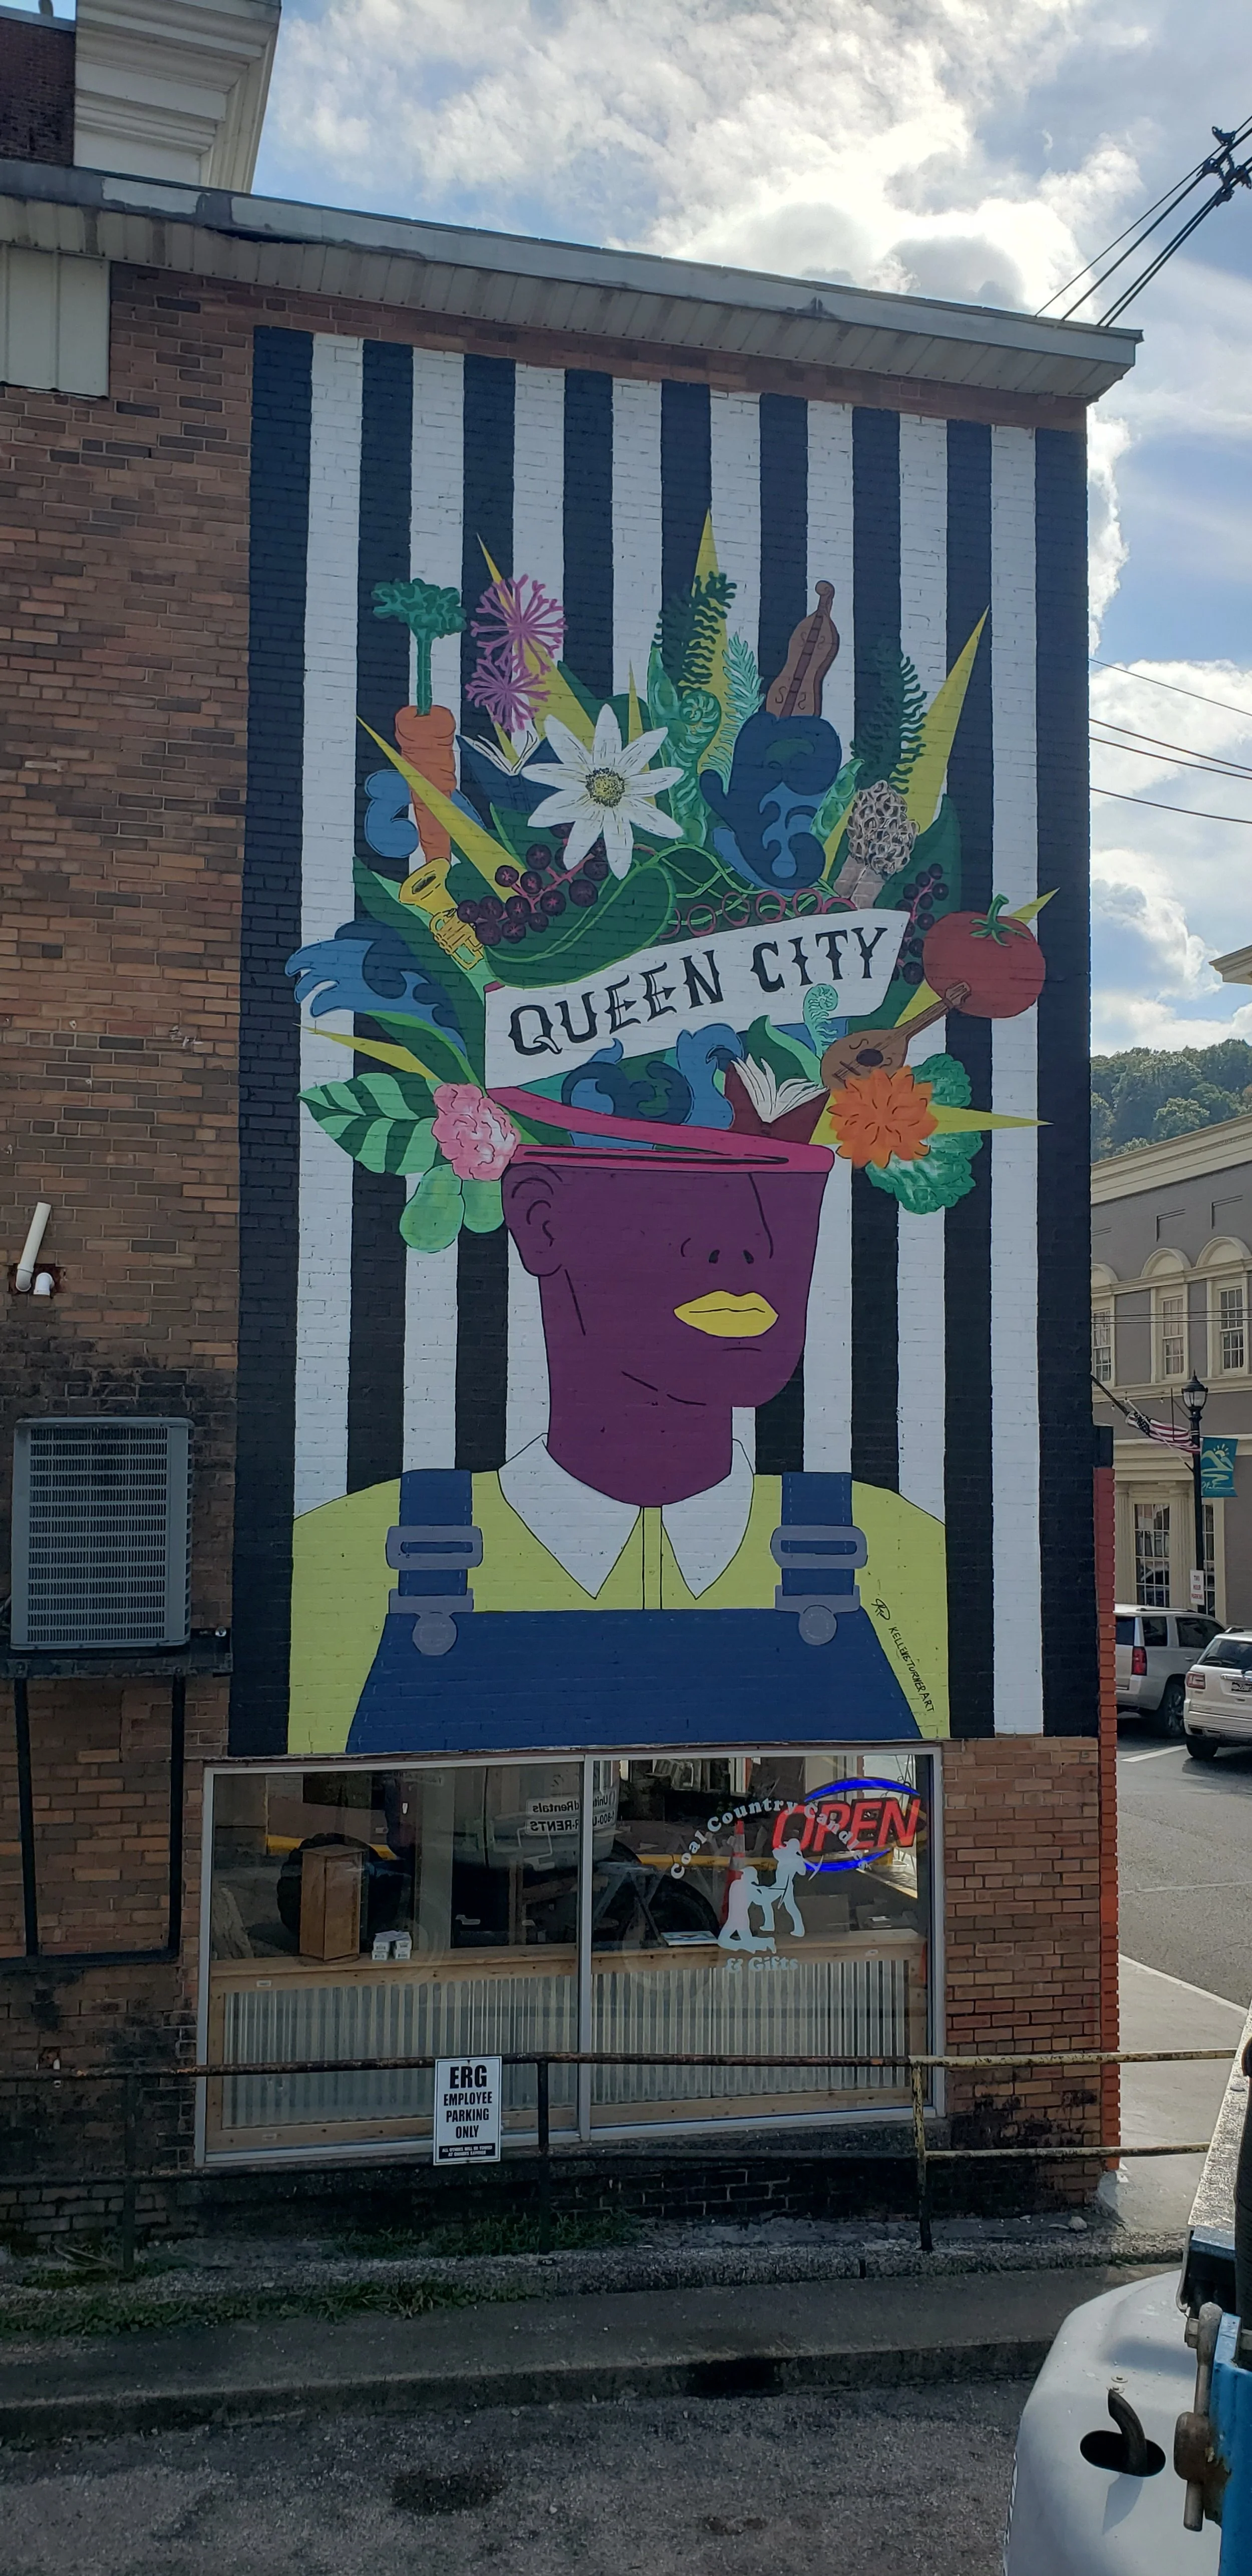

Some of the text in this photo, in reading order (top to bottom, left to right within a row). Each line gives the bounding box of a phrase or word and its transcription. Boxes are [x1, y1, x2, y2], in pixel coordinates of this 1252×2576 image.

[508, 927, 888, 1056] QUEEN CITY
[772, 1799, 921, 1851] OPEN
[671, 1830, 707, 1879] Coal
[707, 1798, 798, 1832] Country
[726, 1956, 798, 1973] & Gifts
[450, 2065, 487, 2089] ERG
[444, 2092, 492, 2106] EMPLOYEE
[446, 2108, 489, 2123] PARKING
[456, 2125, 479, 2139] ONLY
